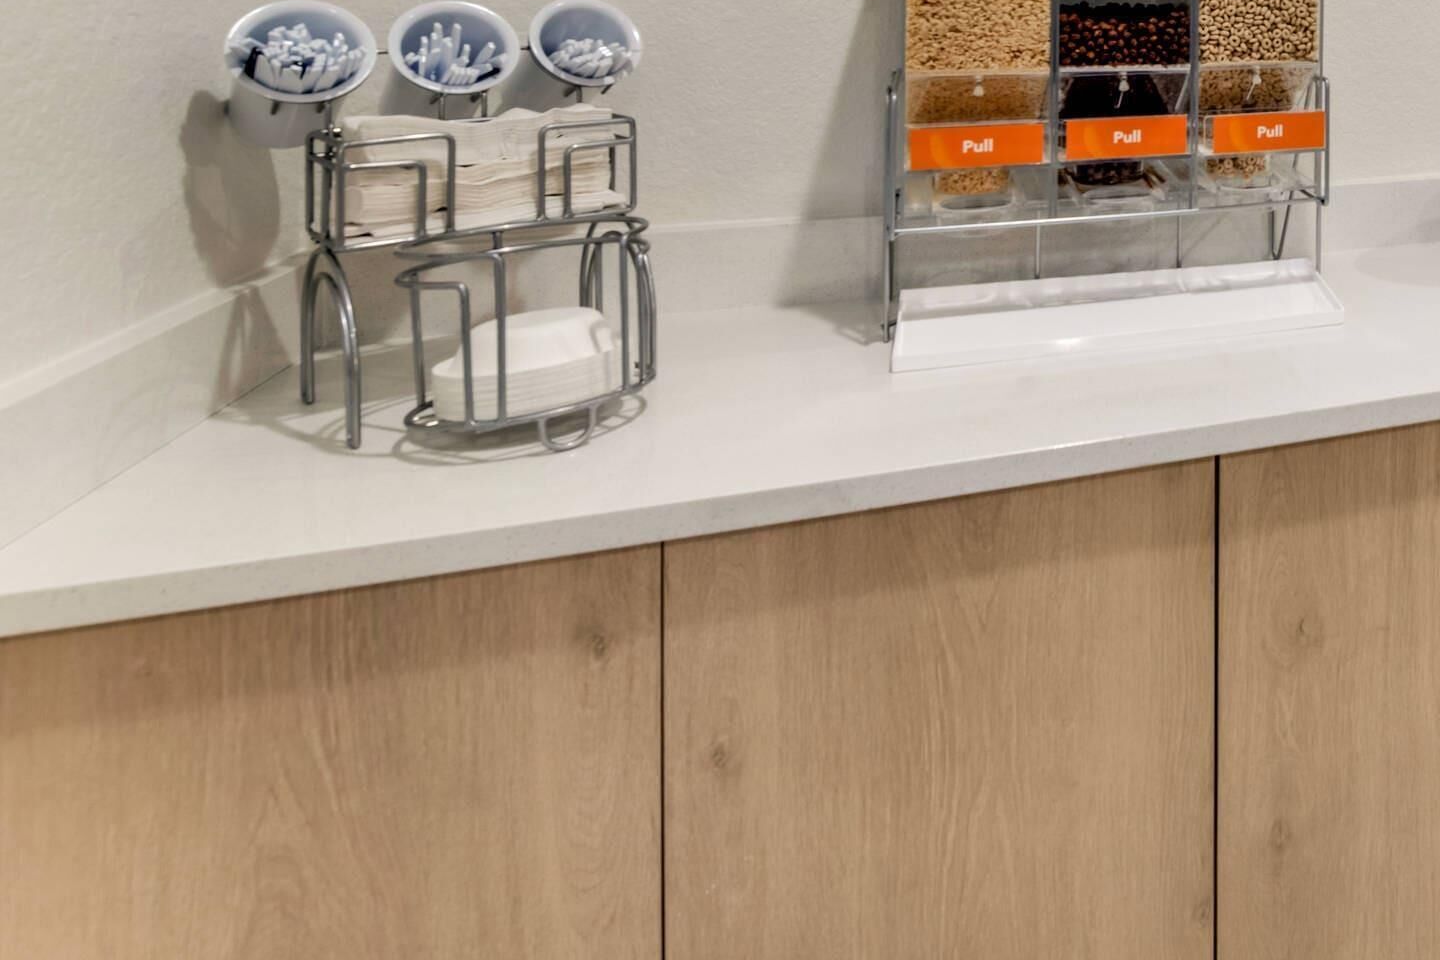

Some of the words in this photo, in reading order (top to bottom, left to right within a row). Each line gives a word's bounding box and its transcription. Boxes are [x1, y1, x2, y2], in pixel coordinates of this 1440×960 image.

[1113, 129, 1142, 145] Pull
[1256, 124, 1284, 140] Pull
[962, 138, 994, 154] Pull
